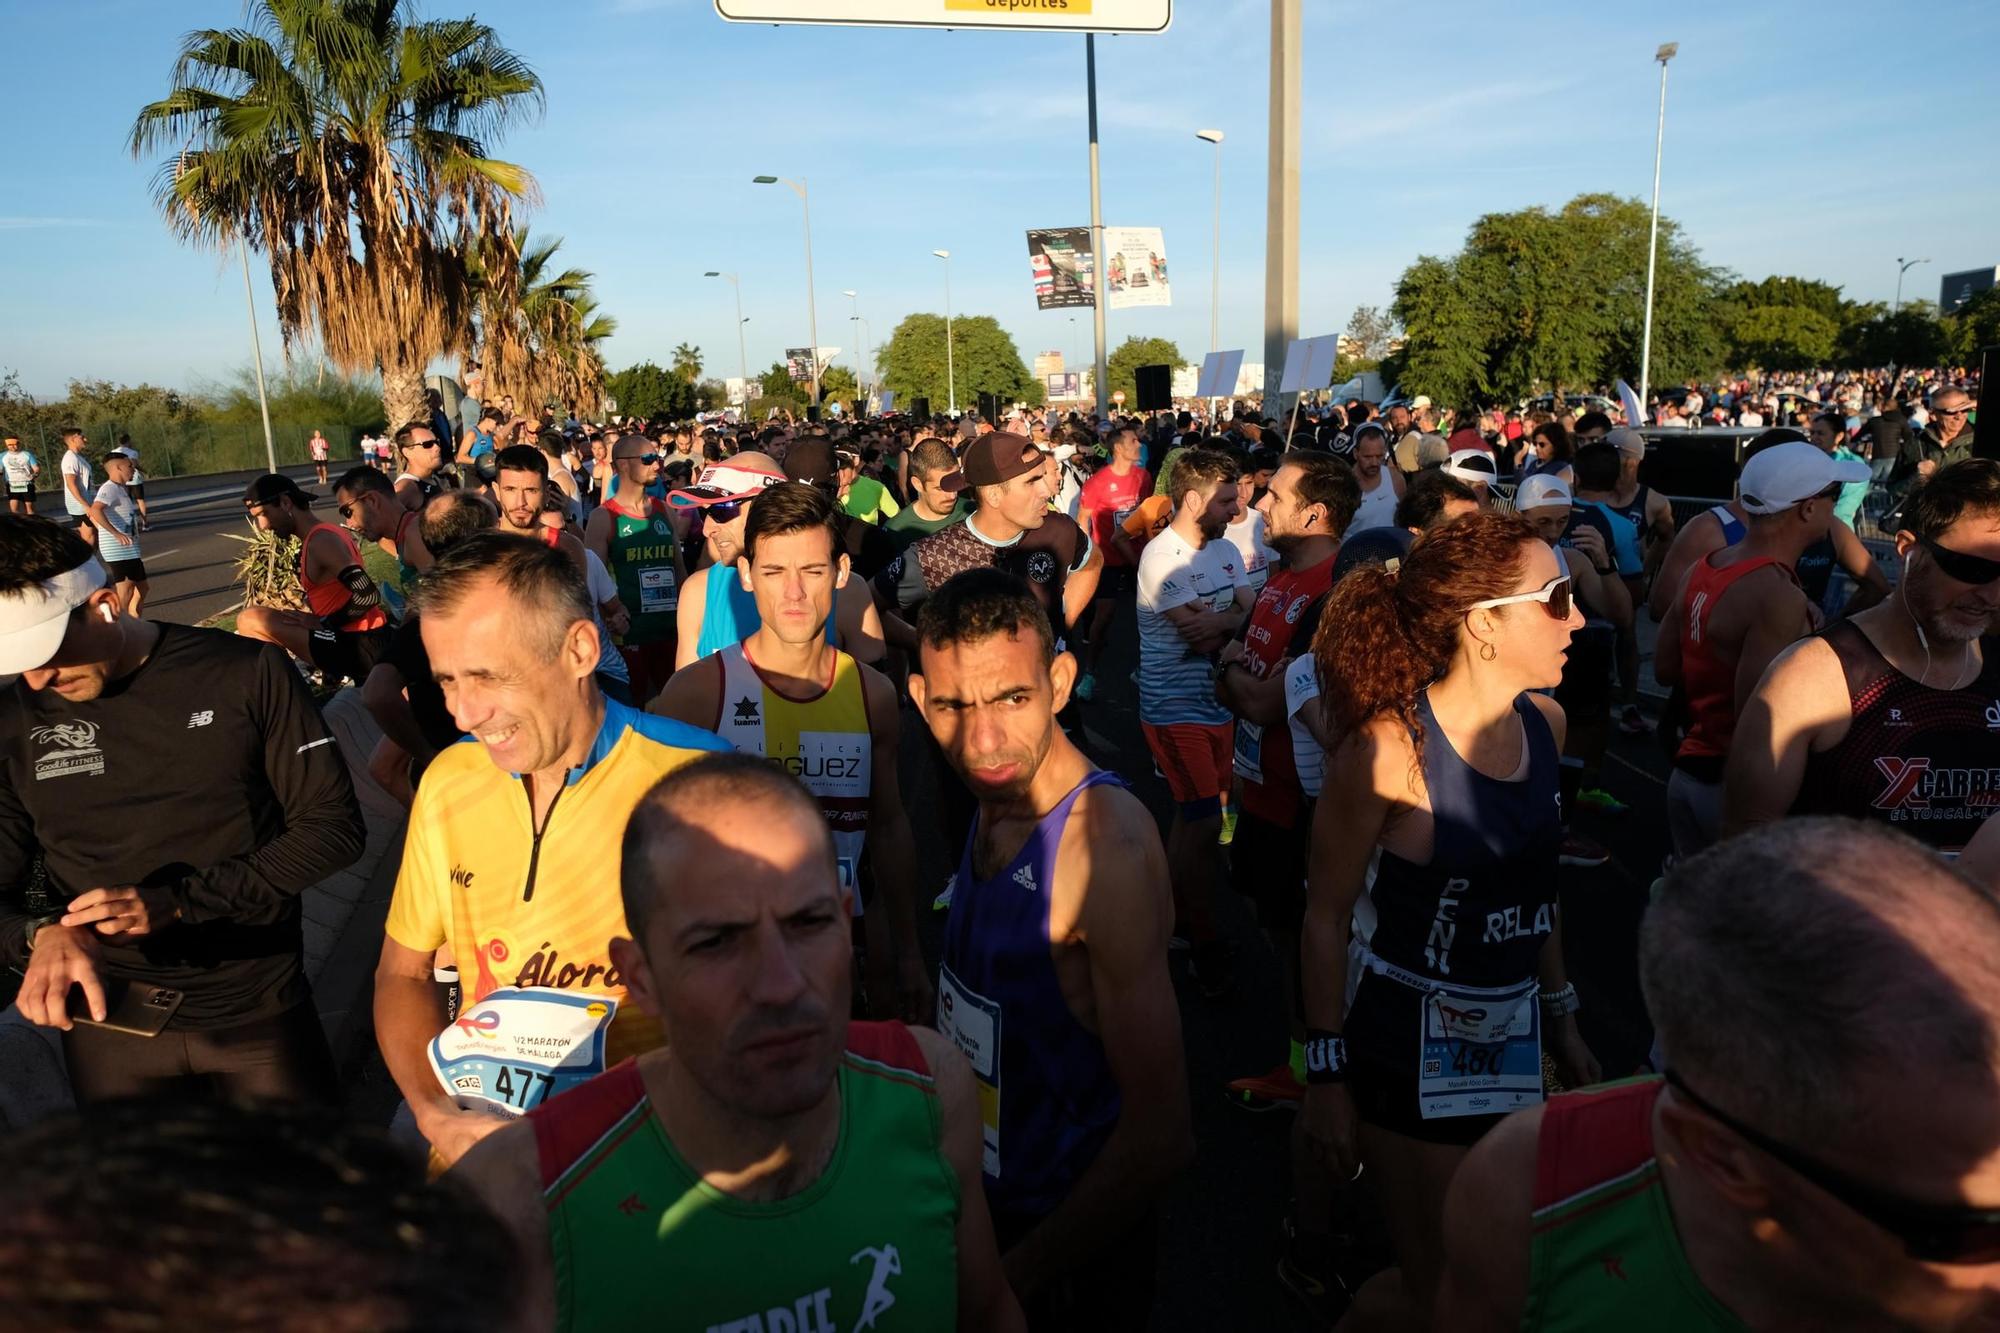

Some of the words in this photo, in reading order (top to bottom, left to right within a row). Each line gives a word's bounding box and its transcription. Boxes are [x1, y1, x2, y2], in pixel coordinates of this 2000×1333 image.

[70, 755, 104, 766] FITNESS
[1012, 872, 1037, 892] adidas
[495, 1066, 556, 1108] 477
